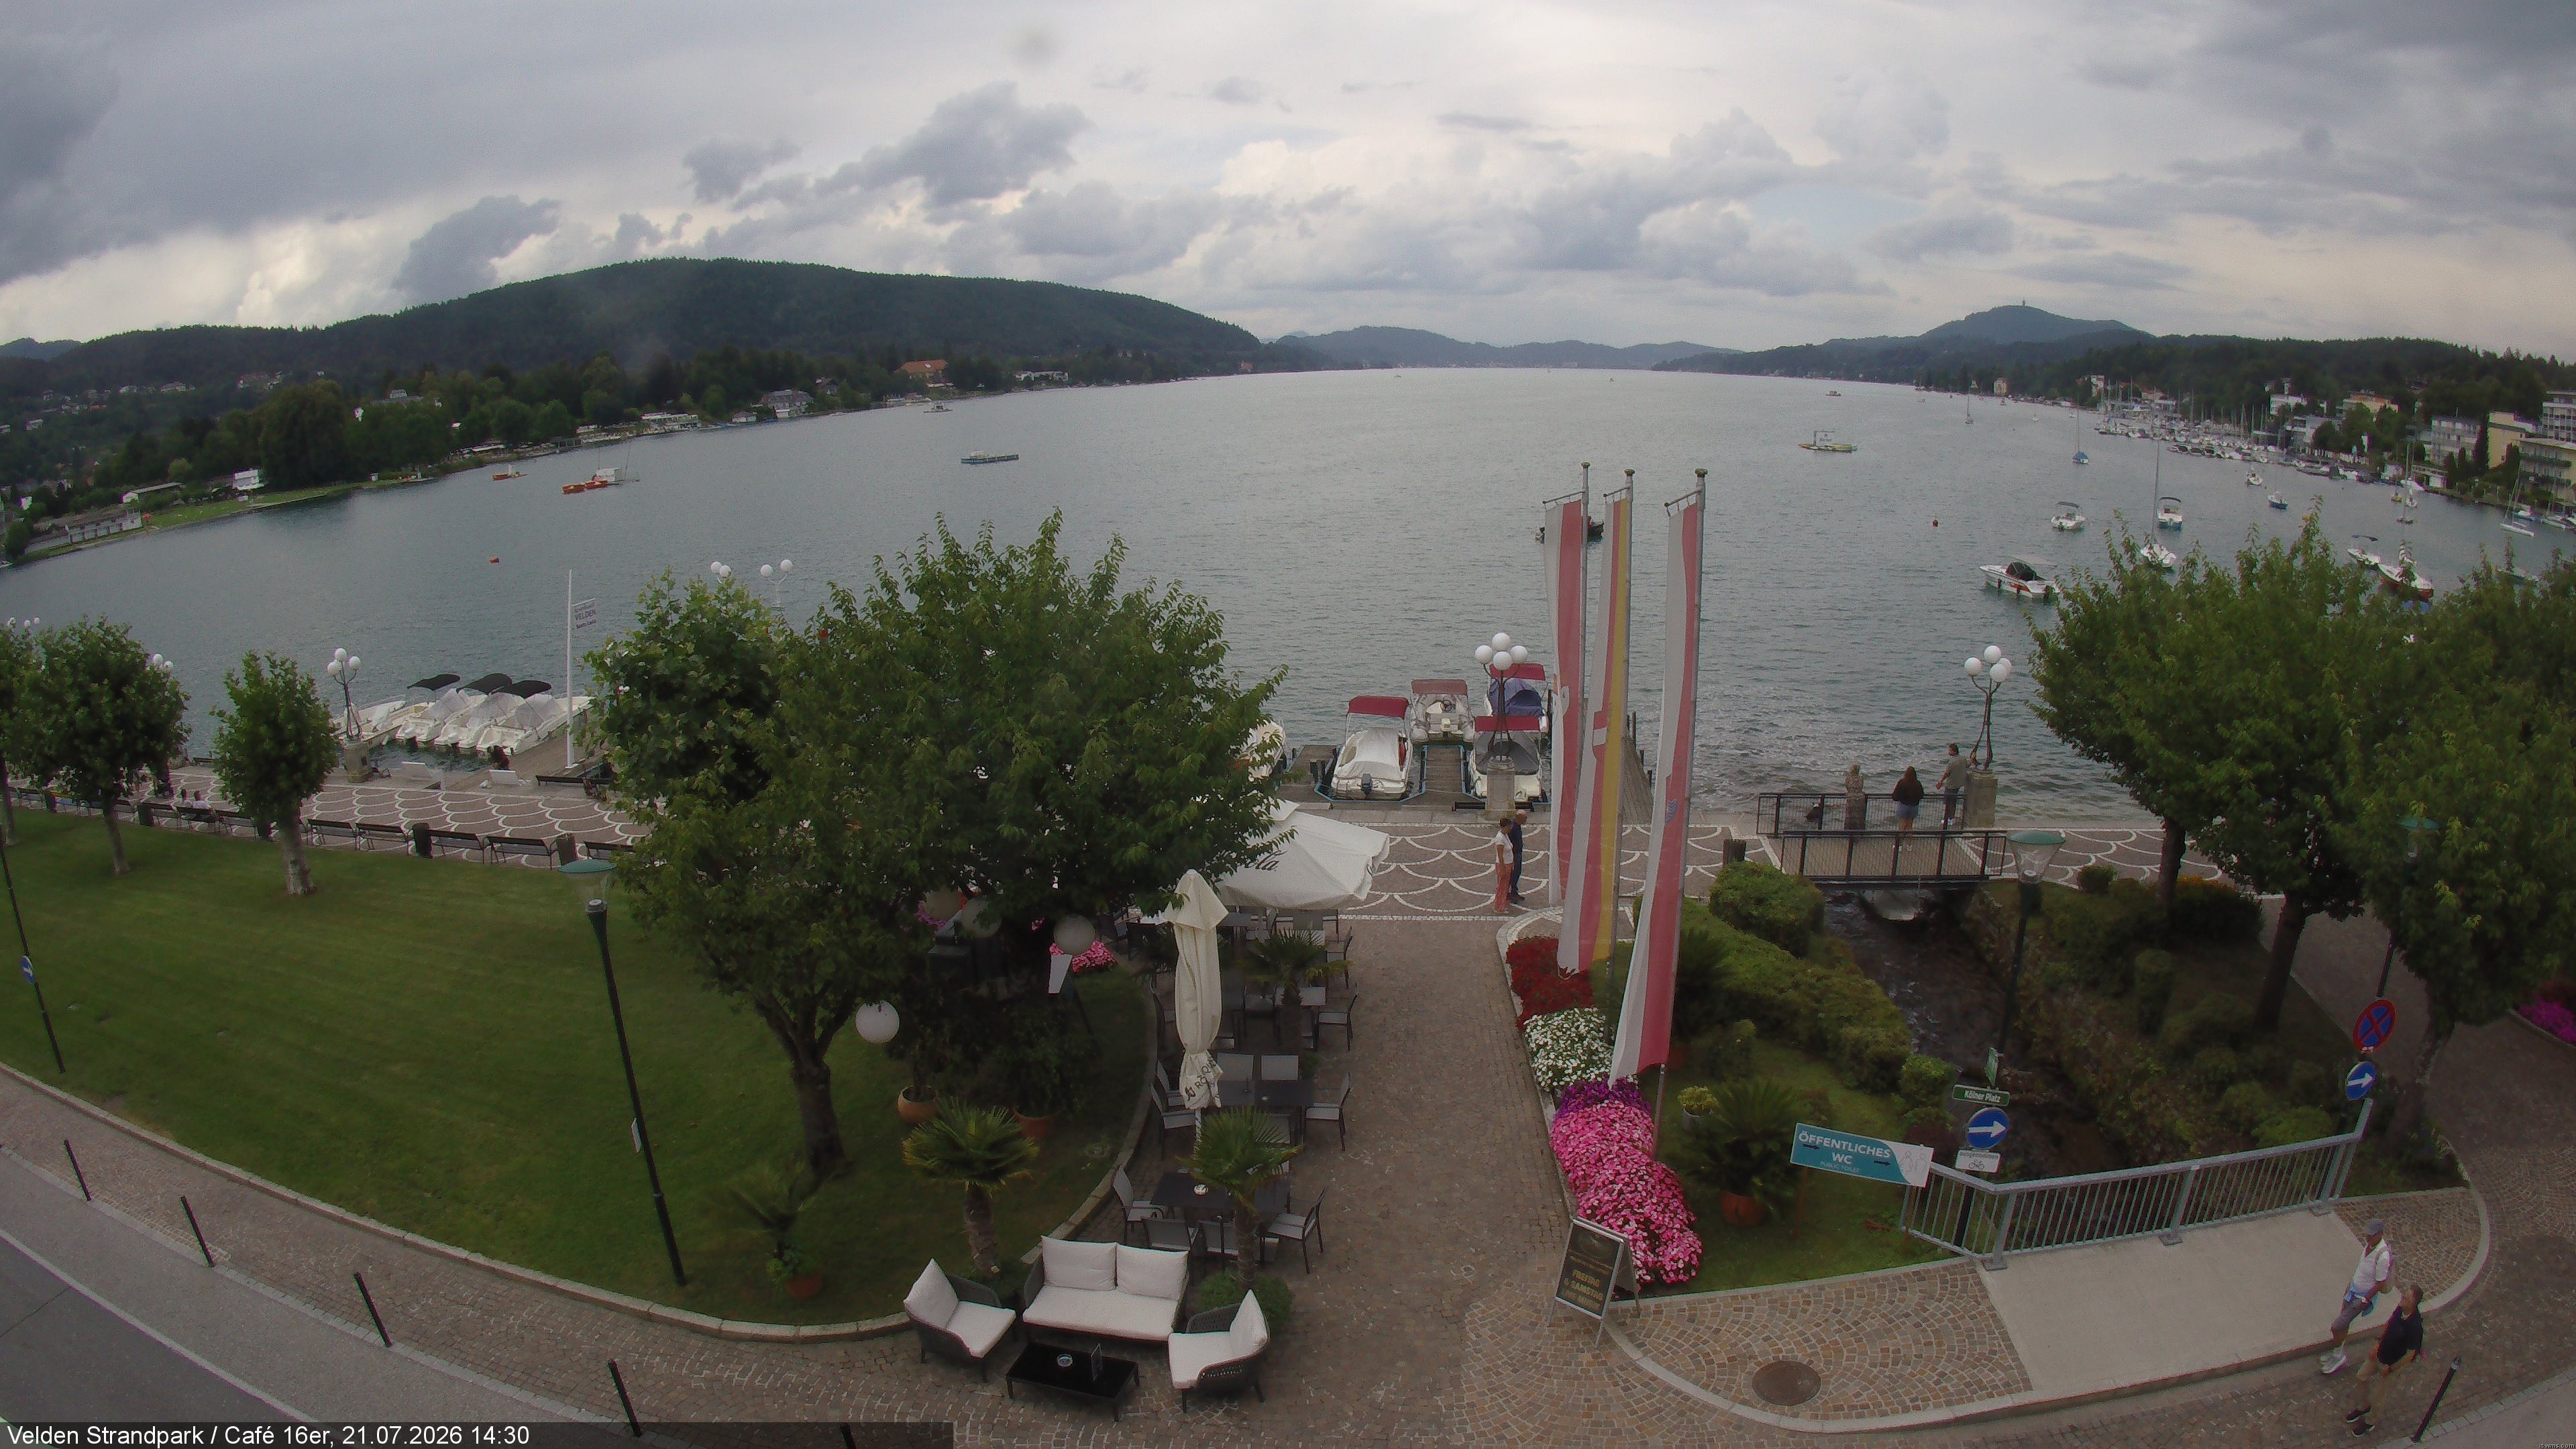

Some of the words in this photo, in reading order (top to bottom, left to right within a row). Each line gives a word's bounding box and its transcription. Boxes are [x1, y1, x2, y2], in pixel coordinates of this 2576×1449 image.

[574, 609, 596, 621] VELDEN
[1985, 1093, 2001, 1102] Platz
[1799, 1130, 1891, 1158] ÖFFENTLICHES
[1832, 1152, 1852, 1165] WC
